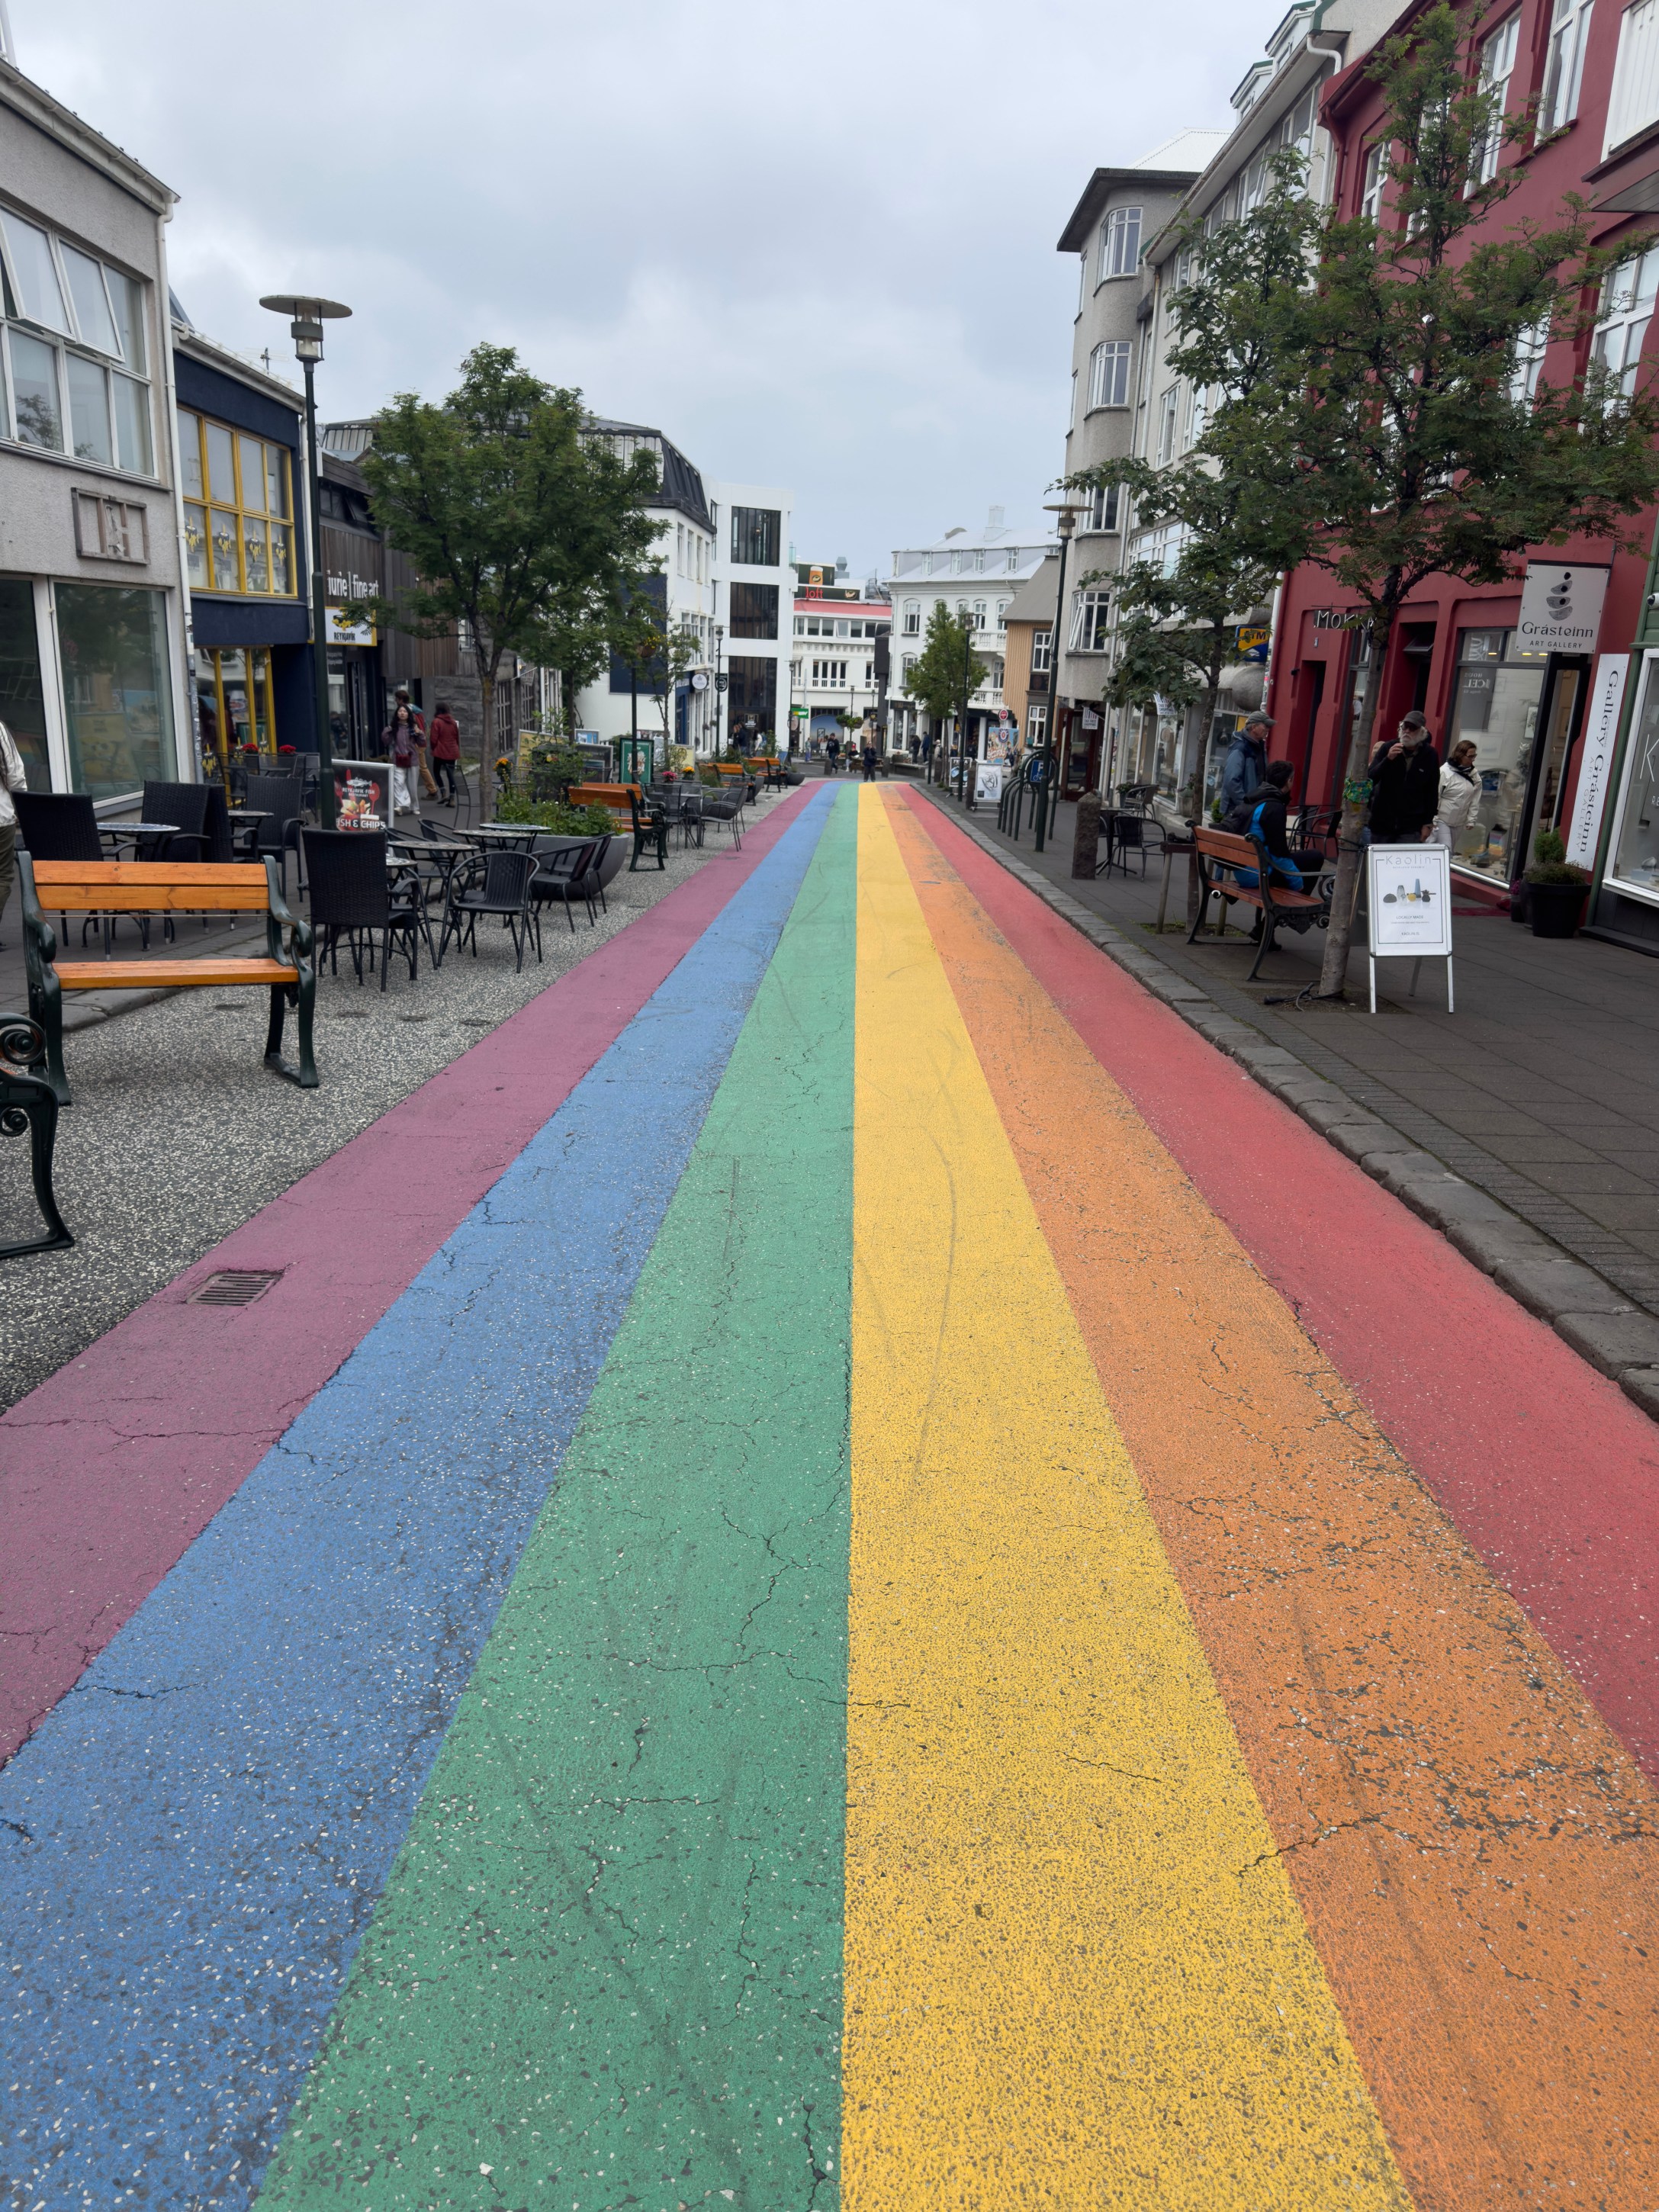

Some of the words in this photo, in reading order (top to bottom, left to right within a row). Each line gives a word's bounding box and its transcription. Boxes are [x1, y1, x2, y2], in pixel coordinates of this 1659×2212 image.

[352, 574, 368, 598] fine
[368, 580, 379, 597] art
[805, 586, 823, 599] loft
[1522, 621, 1593, 638] Grásteinn
[1596, 670, 1619, 747] Gallery
[1580, 754, 1604, 853] Grásteinn
[361, 820, 386, 830] CHIPS
[1576, 789, 1589, 847] GALLERY
[1386, 854, 1431, 865] Kaolin
